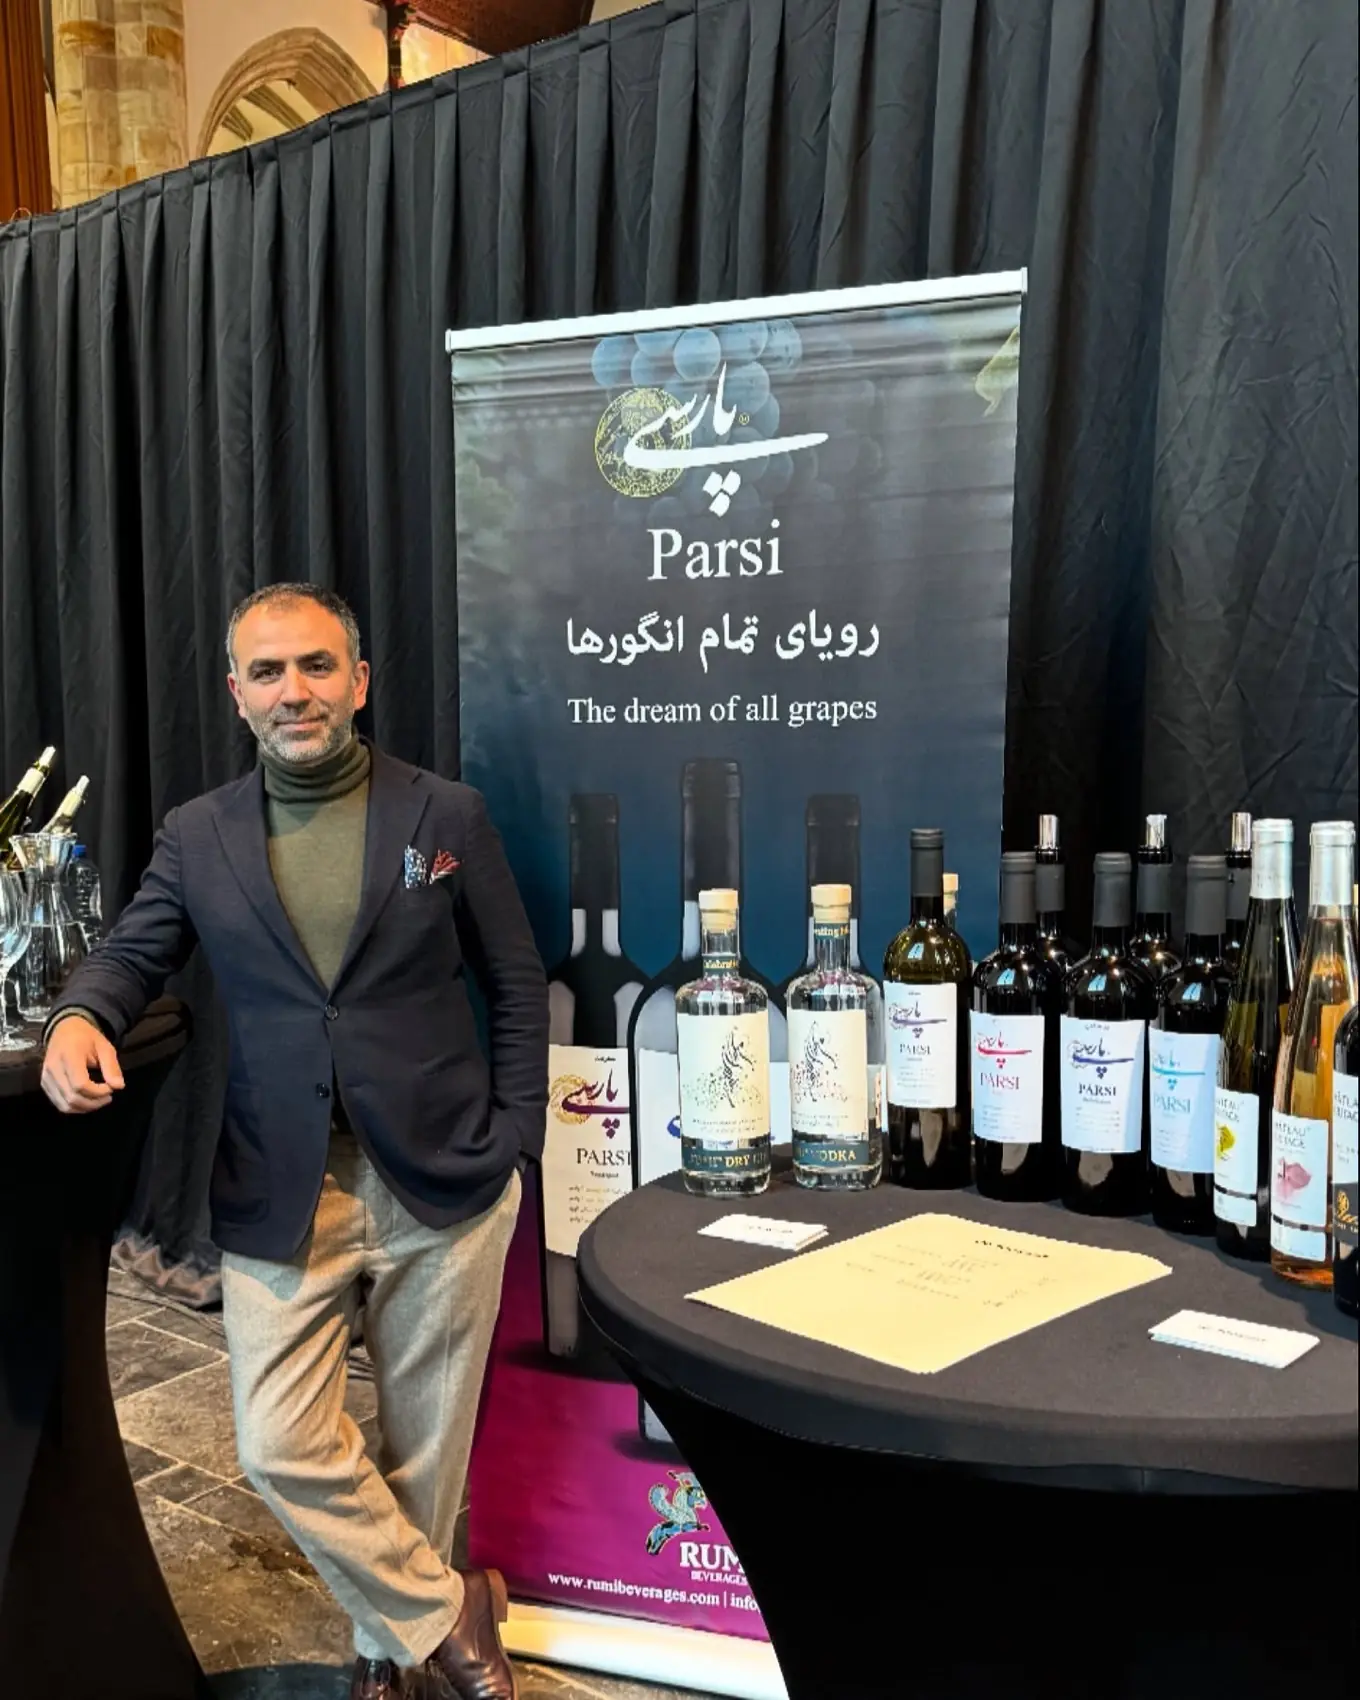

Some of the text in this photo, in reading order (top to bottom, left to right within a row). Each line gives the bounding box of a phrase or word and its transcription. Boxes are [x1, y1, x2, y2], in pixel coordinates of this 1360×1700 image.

[646, 518, 784, 581] Parsi
[567, 608, 880, 673] رویای تمام انگورها
[568, 693, 878, 728] The dream of all grapes
[979, 1072, 1020, 1090] PARSI
[1078, 1082, 1117, 1097] PARSI
[1153, 1092, 1191, 1114] PARSI
[576, 1147, 632, 1167] PARSI
[724, 1153, 751, 1169] DRY
[548, 1573, 762, 1616] www.rumibeverages.com info
